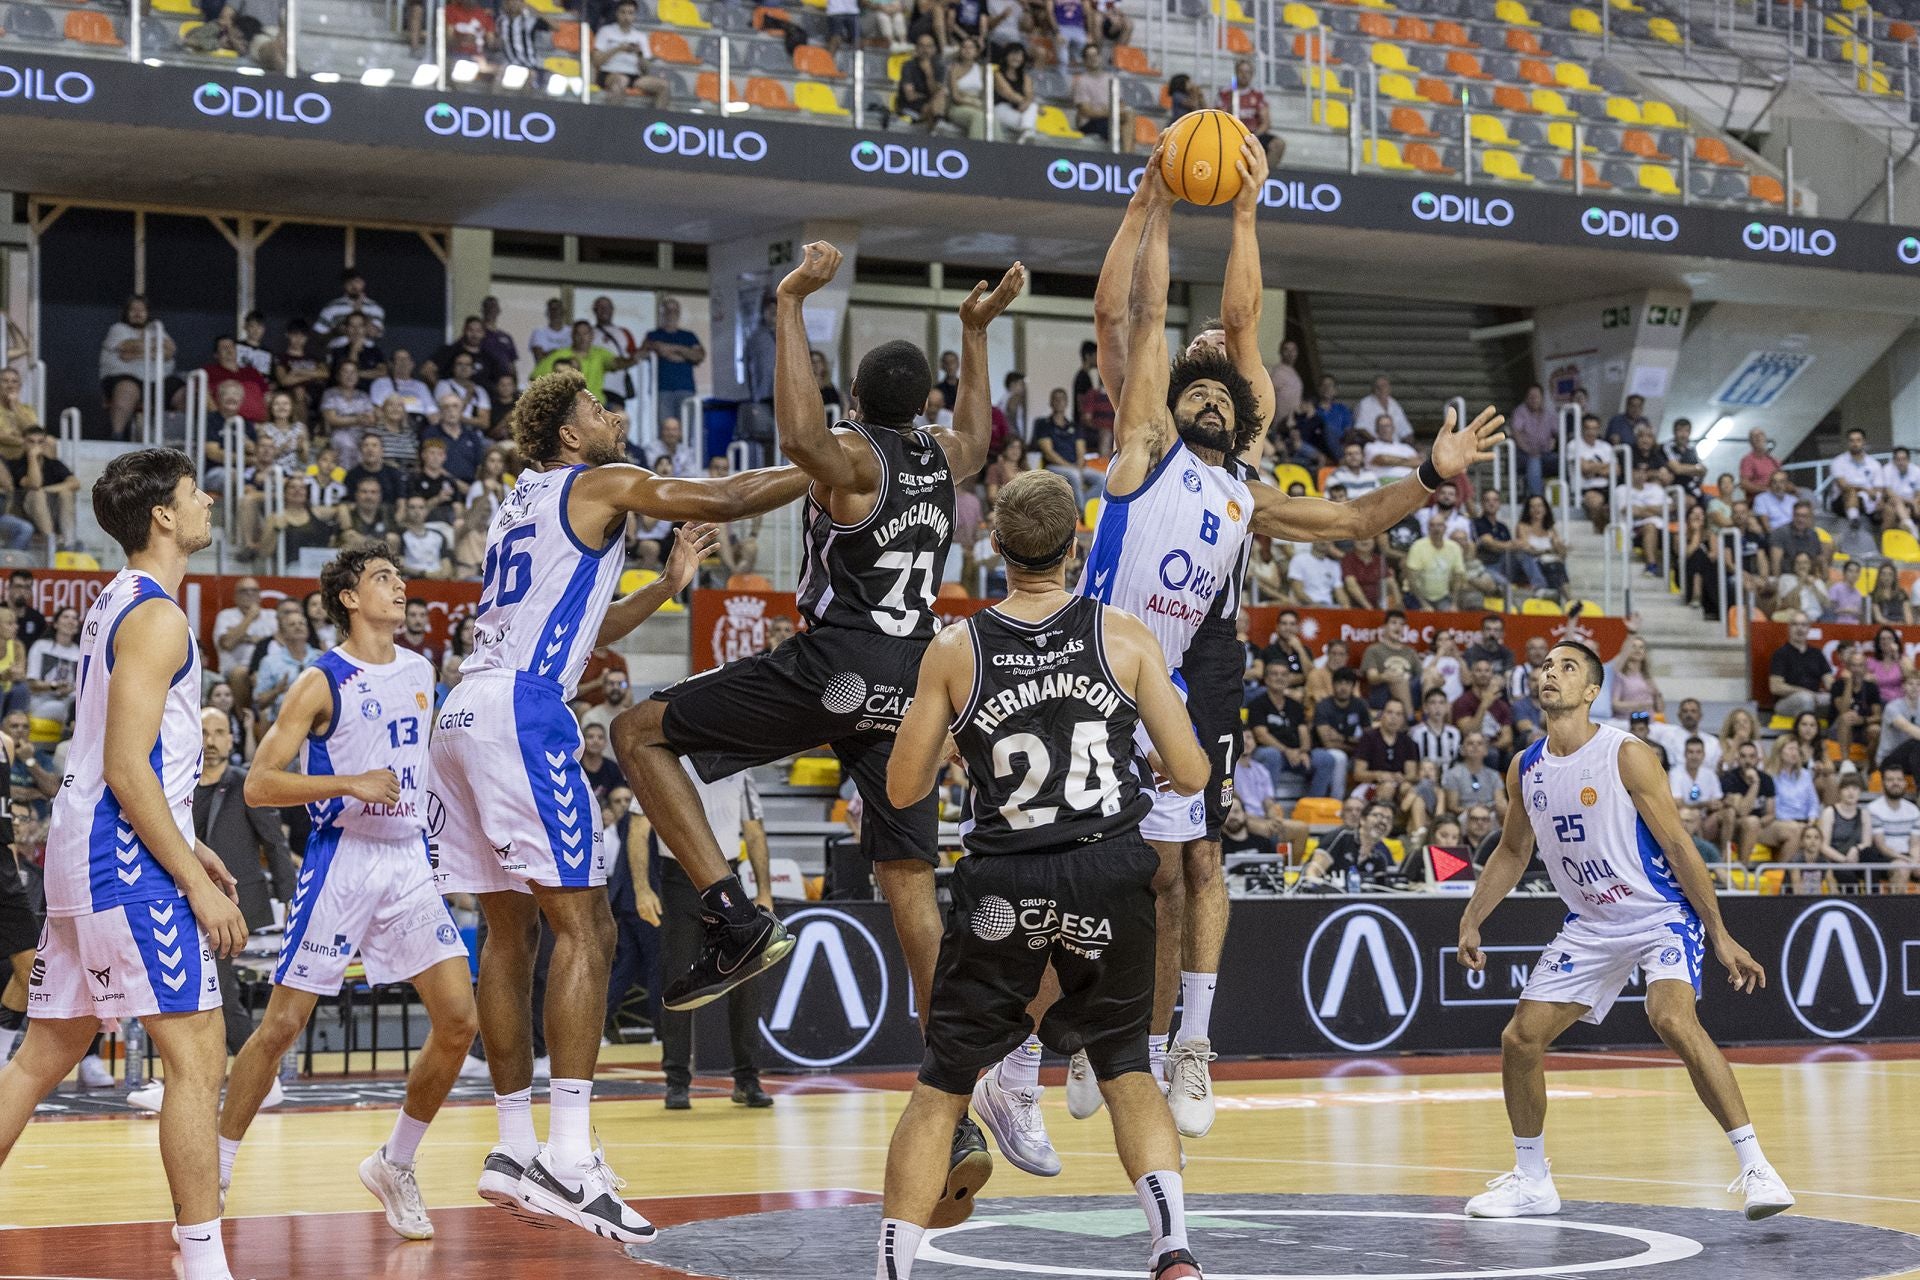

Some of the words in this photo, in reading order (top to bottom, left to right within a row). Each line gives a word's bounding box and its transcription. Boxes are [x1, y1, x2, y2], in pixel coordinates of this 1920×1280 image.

[193, 82, 332, 125] ODILO
[424, 102, 556, 144] ODILO
[643, 122, 767, 162] ODILO
[850, 140, 969, 180] ODILO
[1256, 177, 1342, 213] DILO
[1411, 191, 1514, 227] ODILO
[1581, 207, 1679, 242] ODILO
[1742, 222, 1837, 257] ODILO
[873, 502, 950, 548] UGOCHUKW
[1200, 509, 1220, 546] 8
[478, 523, 536, 617] 26
[992, 655, 1035, 667] CASA
[973, 673, 1121, 735] HERMANSON
[387, 717, 419, 749] 13
[1218, 733, 1234, 774] 7
[992, 720, 1122, 831] 24
[1552, 814, 1586, 842] 25
[1020, 898, 1056, 908] GRUPO
[1019, 909, 1113, 940] CAESA
[301, 939, 338, 958] suma
